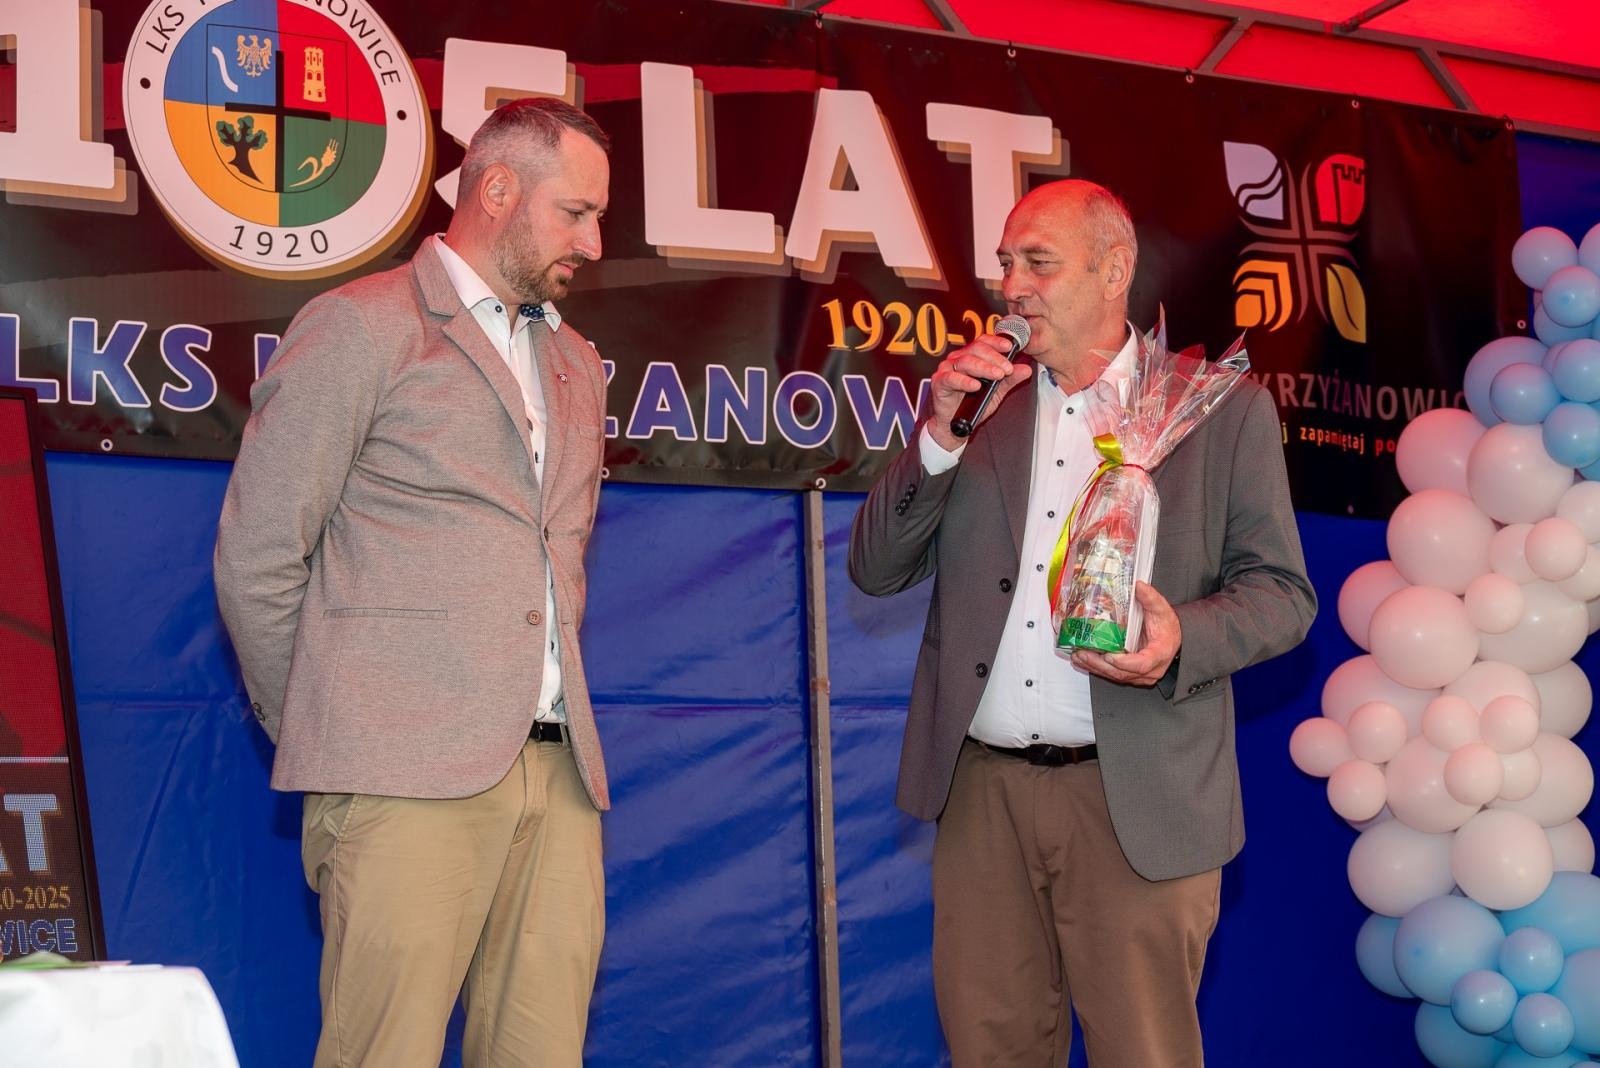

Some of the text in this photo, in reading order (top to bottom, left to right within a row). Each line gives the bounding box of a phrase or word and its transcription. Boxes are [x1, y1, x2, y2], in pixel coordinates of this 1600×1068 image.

[146, 5, 184, 53] LKS
[641, 61, 1053, 280] LAT
[228, 225, 330, 258] 1920
[0, 313, 218, 412] LKS
[1300, 426, 1365, 454] zapamiętaj
[0, 885, 71, 909] 0-2025
